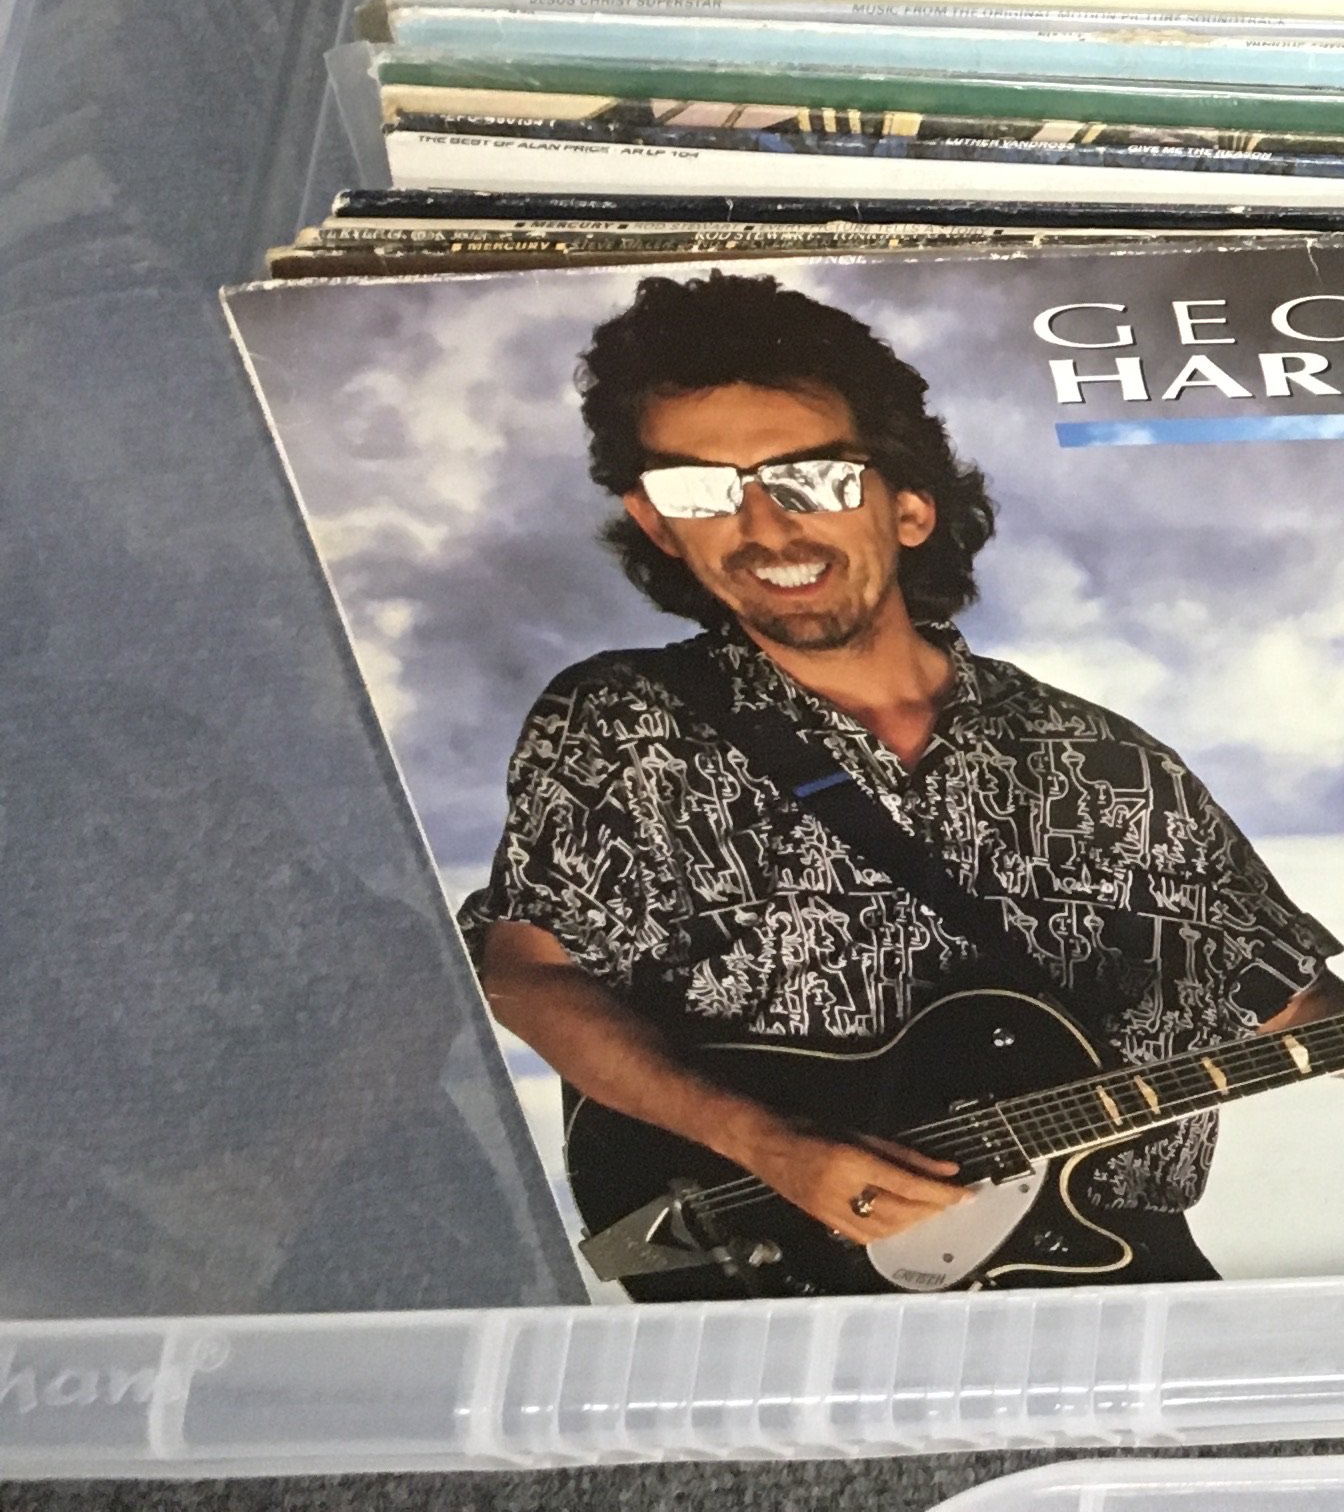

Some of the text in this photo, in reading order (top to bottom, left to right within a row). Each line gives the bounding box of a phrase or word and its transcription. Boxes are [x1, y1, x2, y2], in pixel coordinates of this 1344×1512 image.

[418, 135, 561, 151] THE BEST OF ALAN
[946, 137, 999, 148] LUTHER
[1003, 140, 1076, 151] VANDROSS
[1128, 145, 1157, 154] GIVE
[1161, 146, 1184, 156] ME
[1187, 146, 1212, 157] THE
[532, 221, 614, 229] MERCURY
[468, 243, 550, 251] MERCURY
